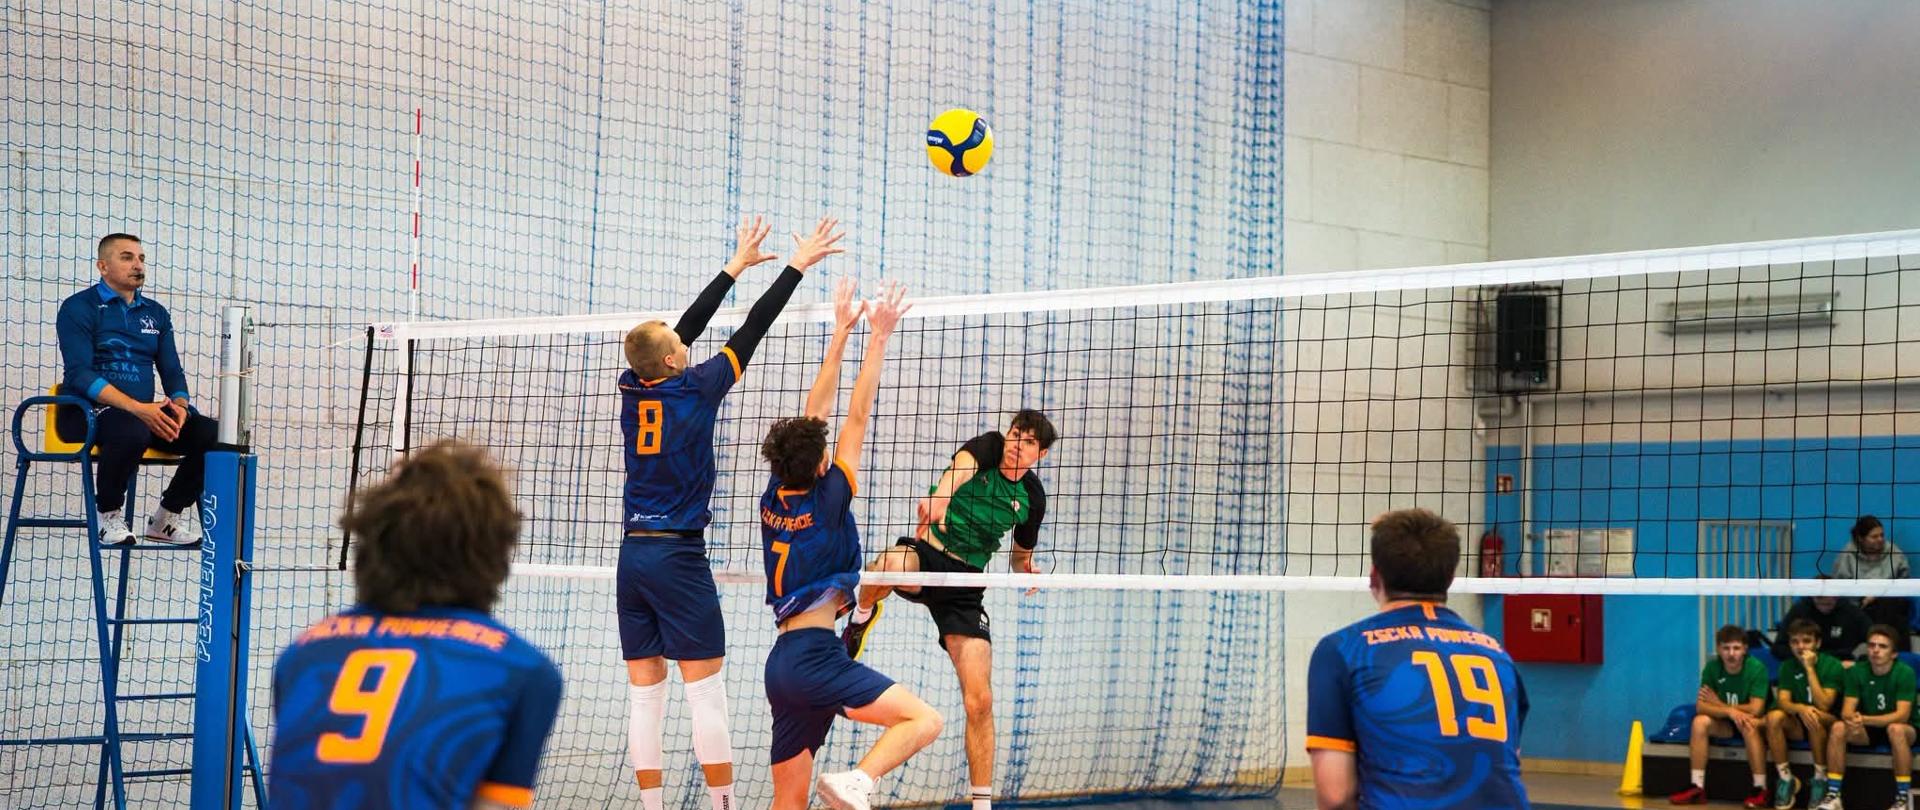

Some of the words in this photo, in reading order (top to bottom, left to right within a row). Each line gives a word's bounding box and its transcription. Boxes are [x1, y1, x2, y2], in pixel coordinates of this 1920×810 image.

[636, 400, 663, 455] 8
[197, 494, 217, 663] PESMENPOL
[771, 541, 791, 598] 7
[315, 648, 417, 764] 9
[1411, 650, 1508, 743] 19
[1877, 693, 1886, 710] 3
